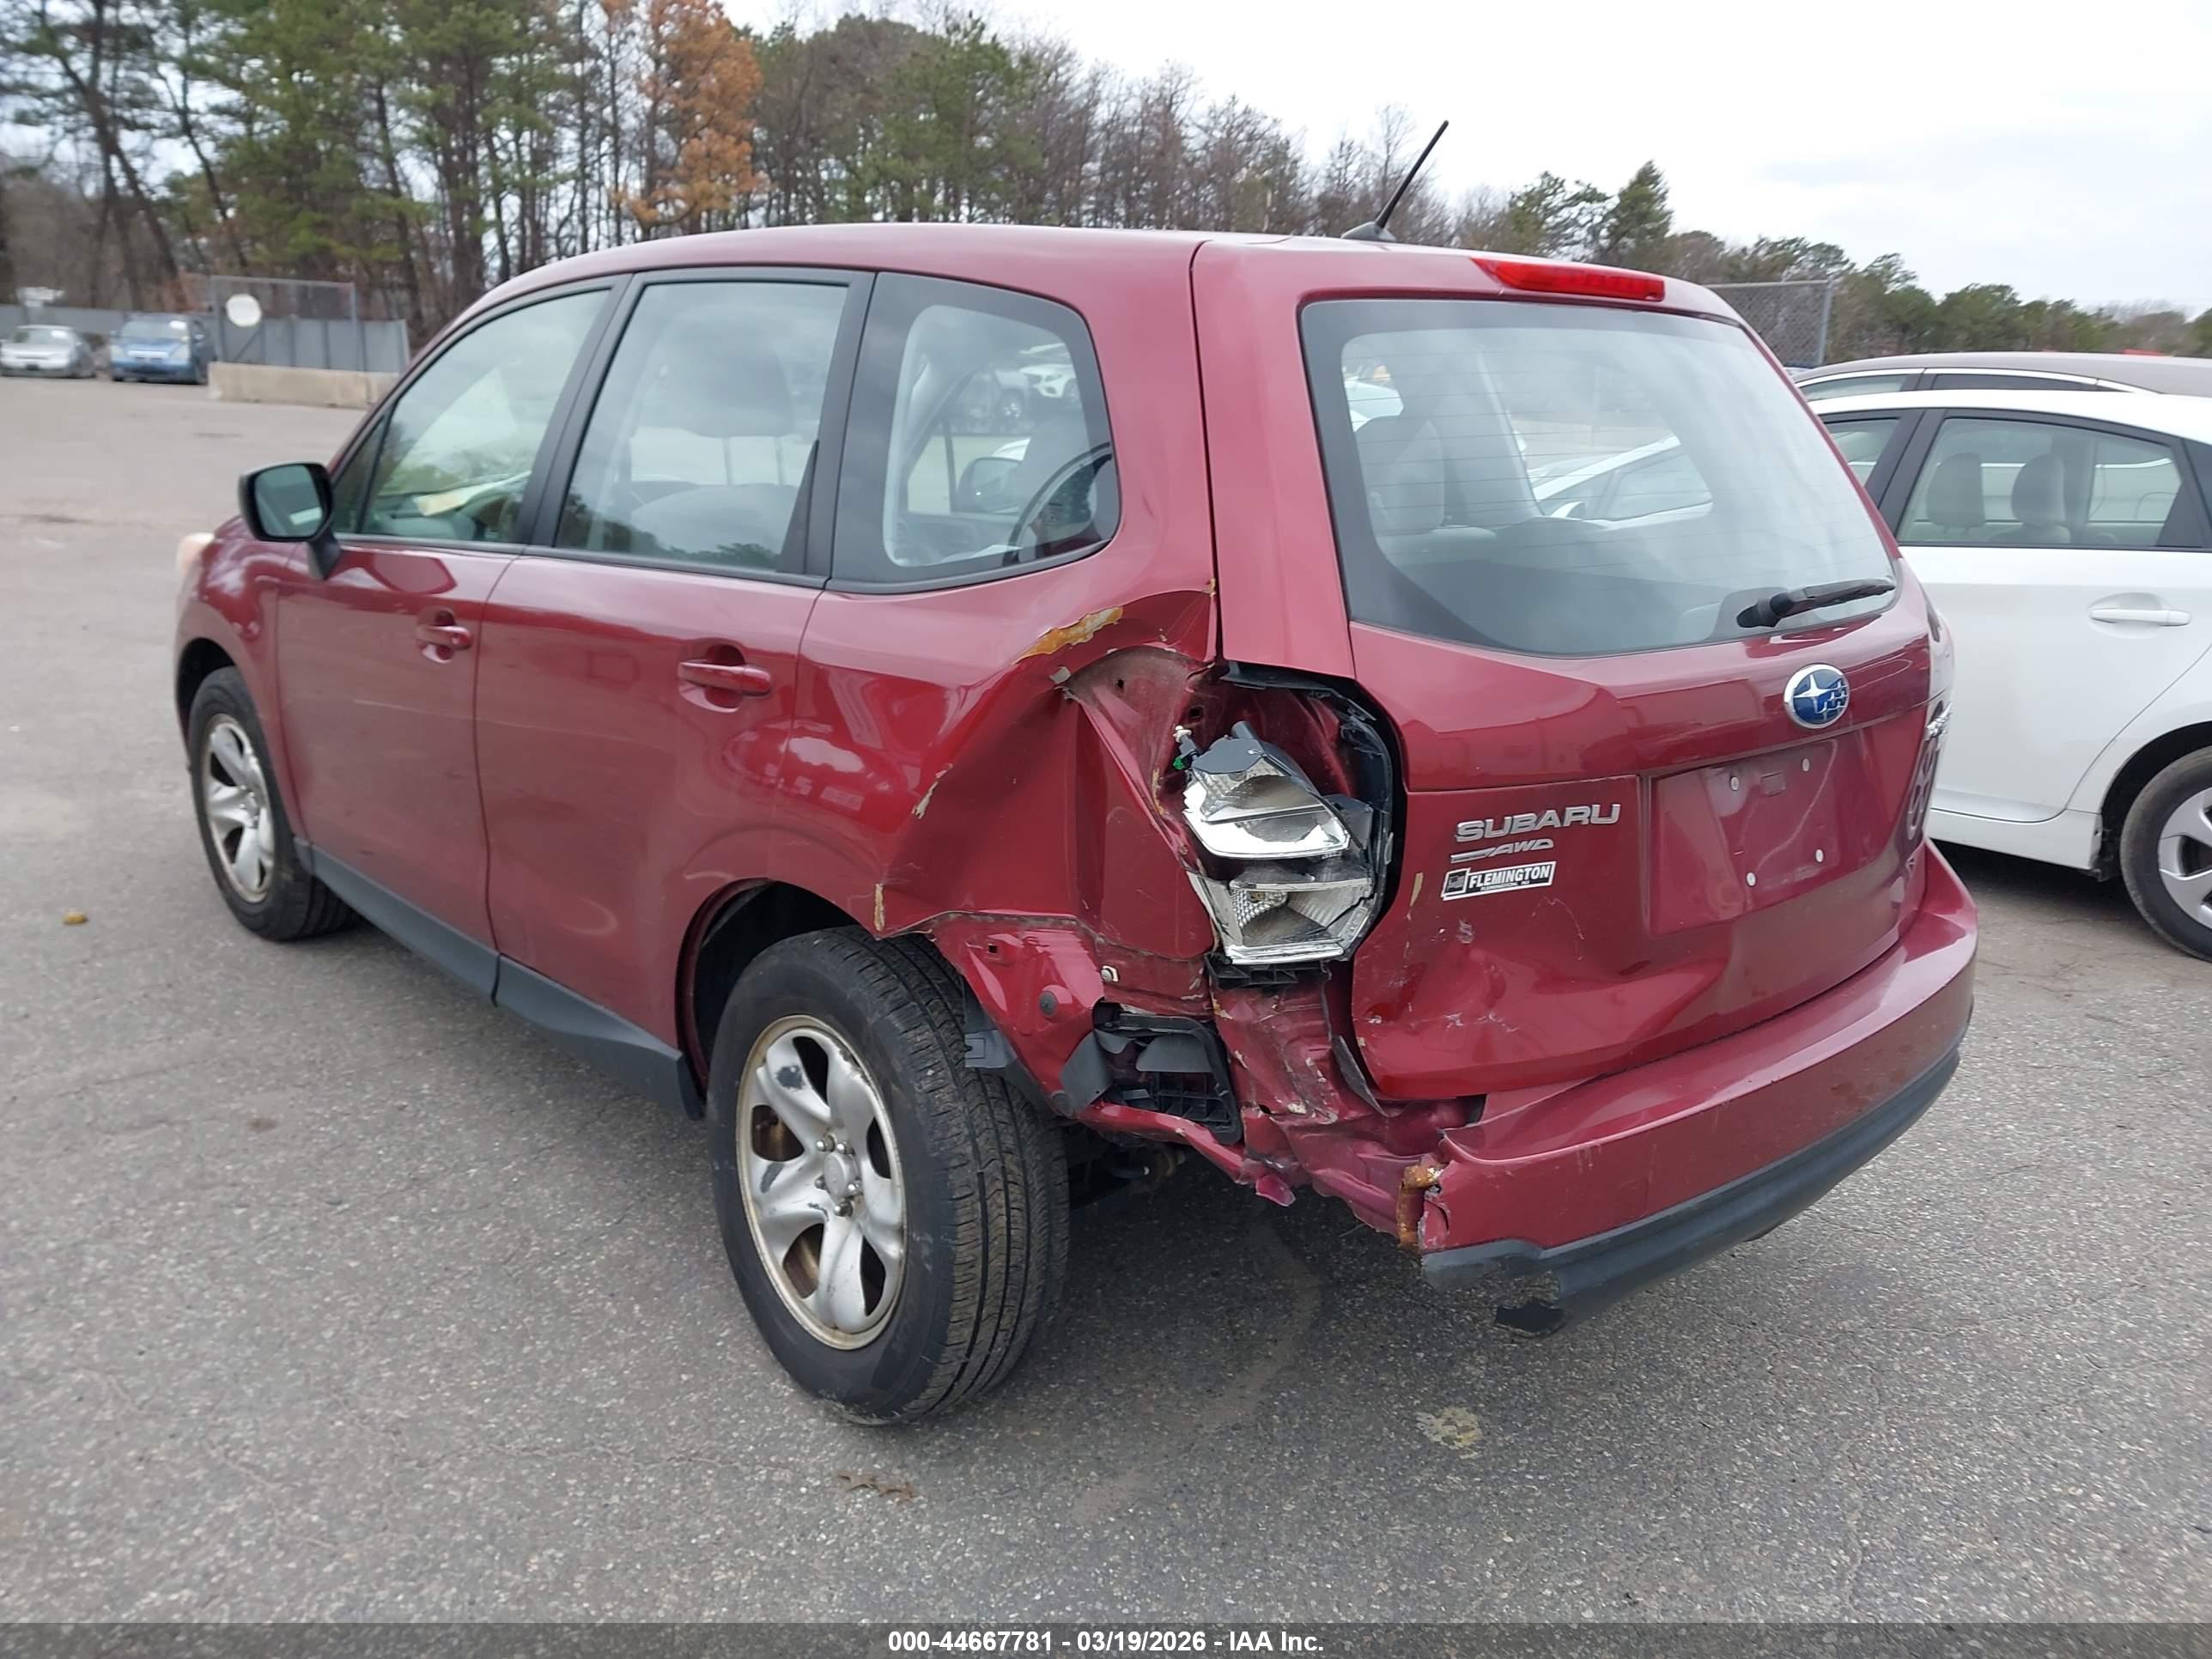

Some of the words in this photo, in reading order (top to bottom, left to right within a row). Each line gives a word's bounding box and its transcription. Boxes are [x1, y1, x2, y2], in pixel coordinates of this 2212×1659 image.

[1455, 804, 1621, 842] SUBARU
[1489, 838, 1553, 857] AWD
[1468, 865, 1551, 889] FLEMINGTON
